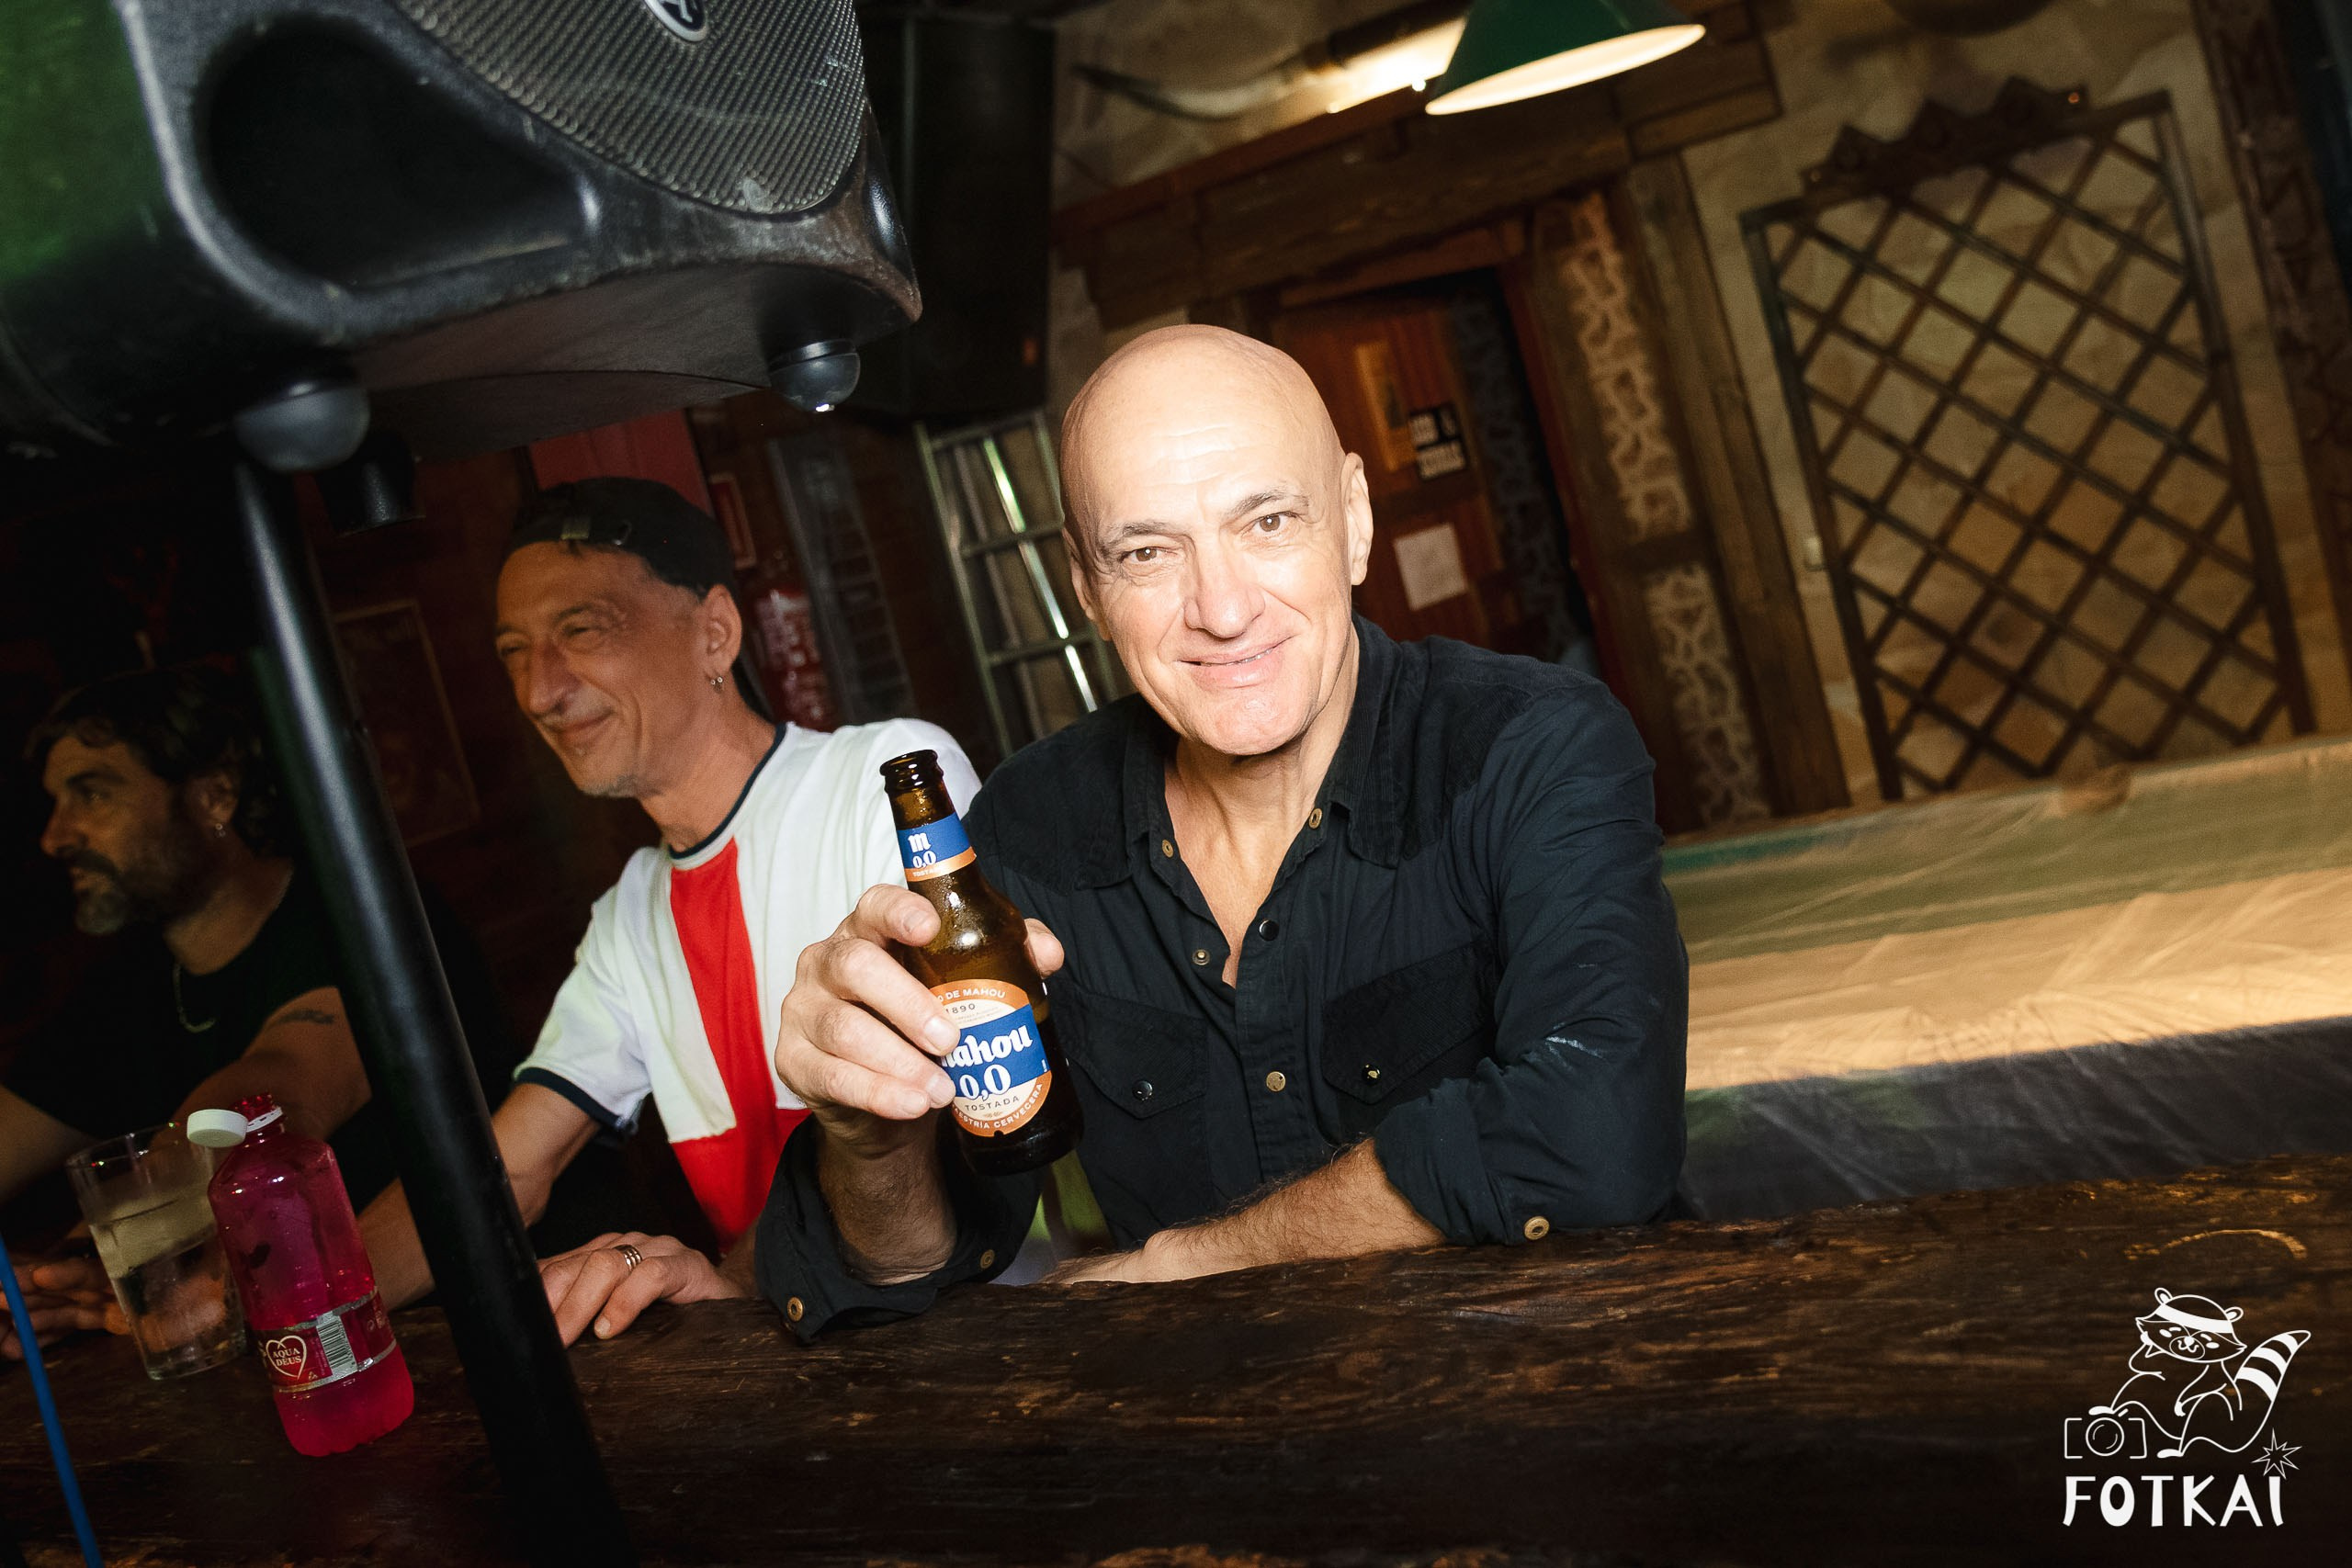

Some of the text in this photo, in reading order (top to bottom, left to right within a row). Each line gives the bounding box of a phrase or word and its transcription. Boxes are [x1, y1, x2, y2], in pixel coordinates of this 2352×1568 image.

[908, 832, 932, 853] m
[945, 989, 961, 1000] DE
[962, 987, 1006, 999] MAHOU
[959, 1064, 1012, 1101] 0,0
[964, 1095, 1020, 1111] TOSTADA
[993, 1083, 1043, 1129] CERVECERA
[273, 1348, 300, 1359] AQUA
[276, 1356, 302, 1367] DEUS
